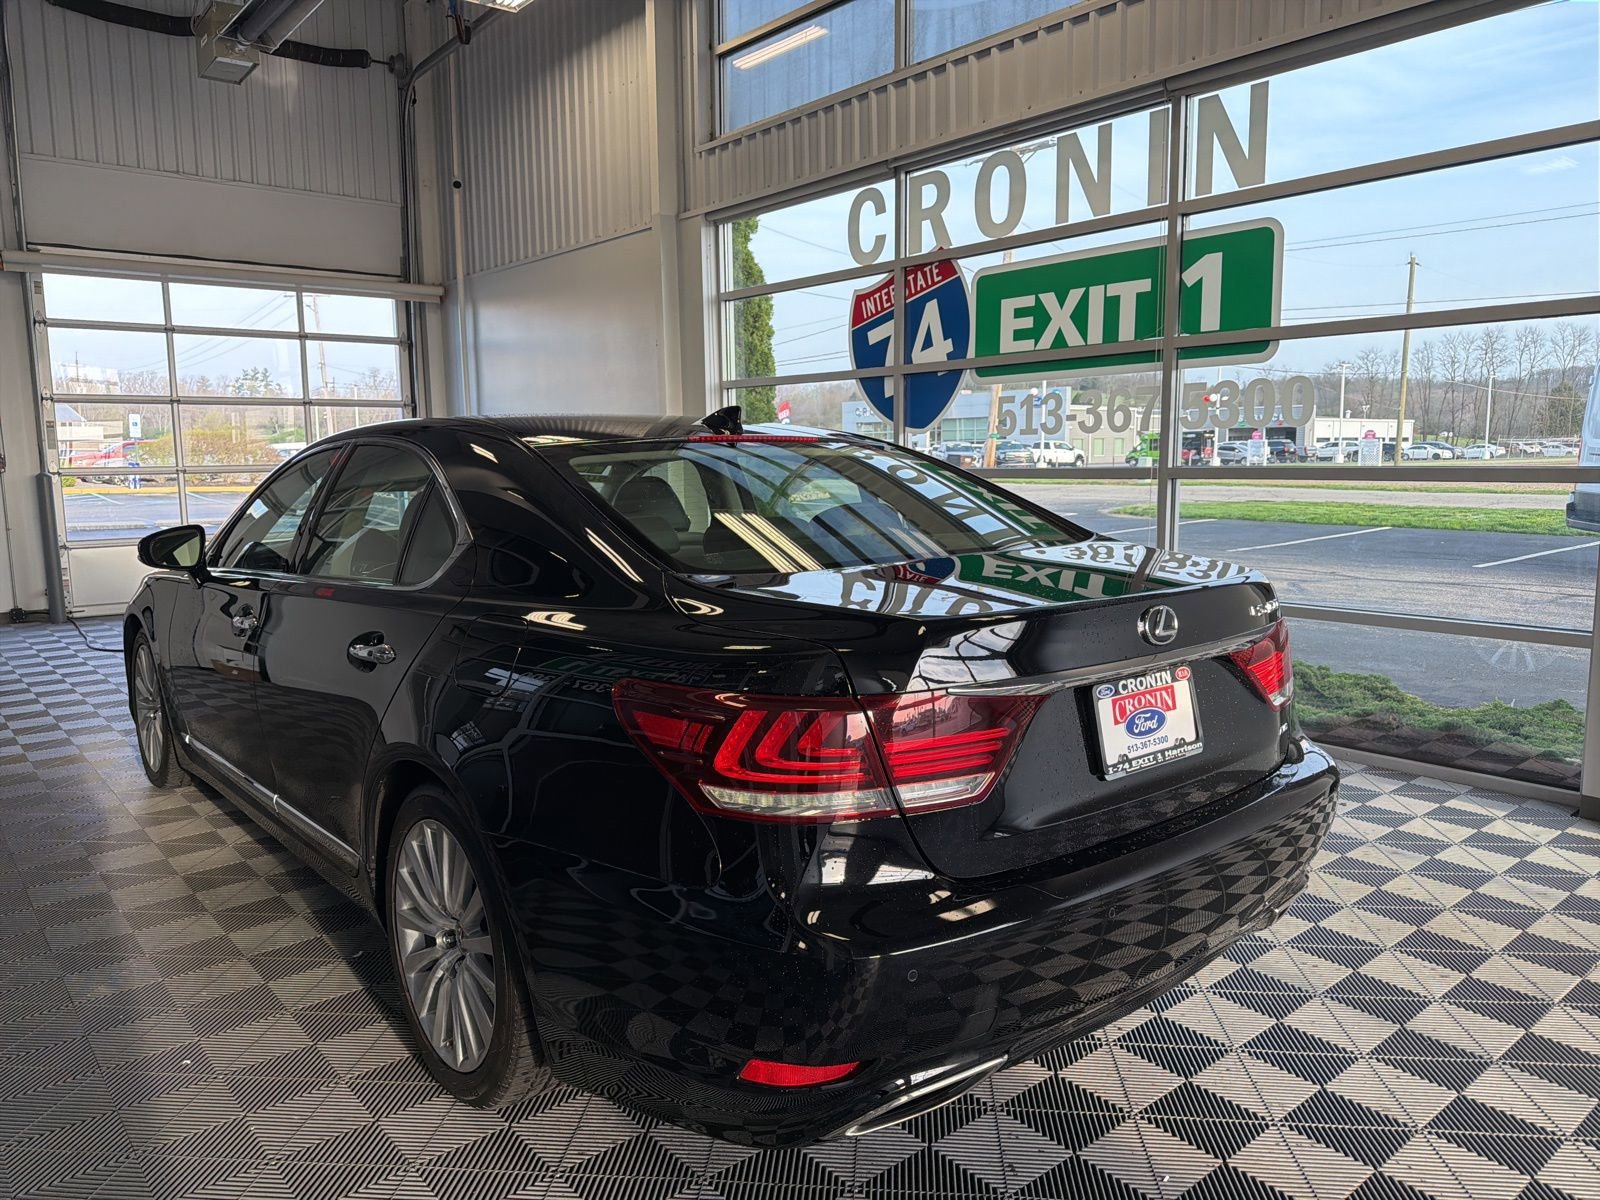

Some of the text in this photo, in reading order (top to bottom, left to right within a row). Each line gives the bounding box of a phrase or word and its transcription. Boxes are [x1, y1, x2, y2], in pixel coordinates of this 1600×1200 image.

[847, 80, 1269, 266] CRONIN
[861, 262, 943, 319] INTERTATE
[999, 251, 1223, 354] EXIT 1
[867, 298, 954, 398] 74
[997, 375, 1315, 437] 513-3675300
[1118, 670, 1172, 694] CRONIN
[1115, 688, 1174, 722] CRONIN
[1133, 712, 1159, 734] Ford
[1107, 763, 1130, 775] I-74
[1131, 756, 1155, 769] EXIT
[1165, 742, 1203, 757] Harrison
[1127, 735, 1169, 754] 513-367-5300
